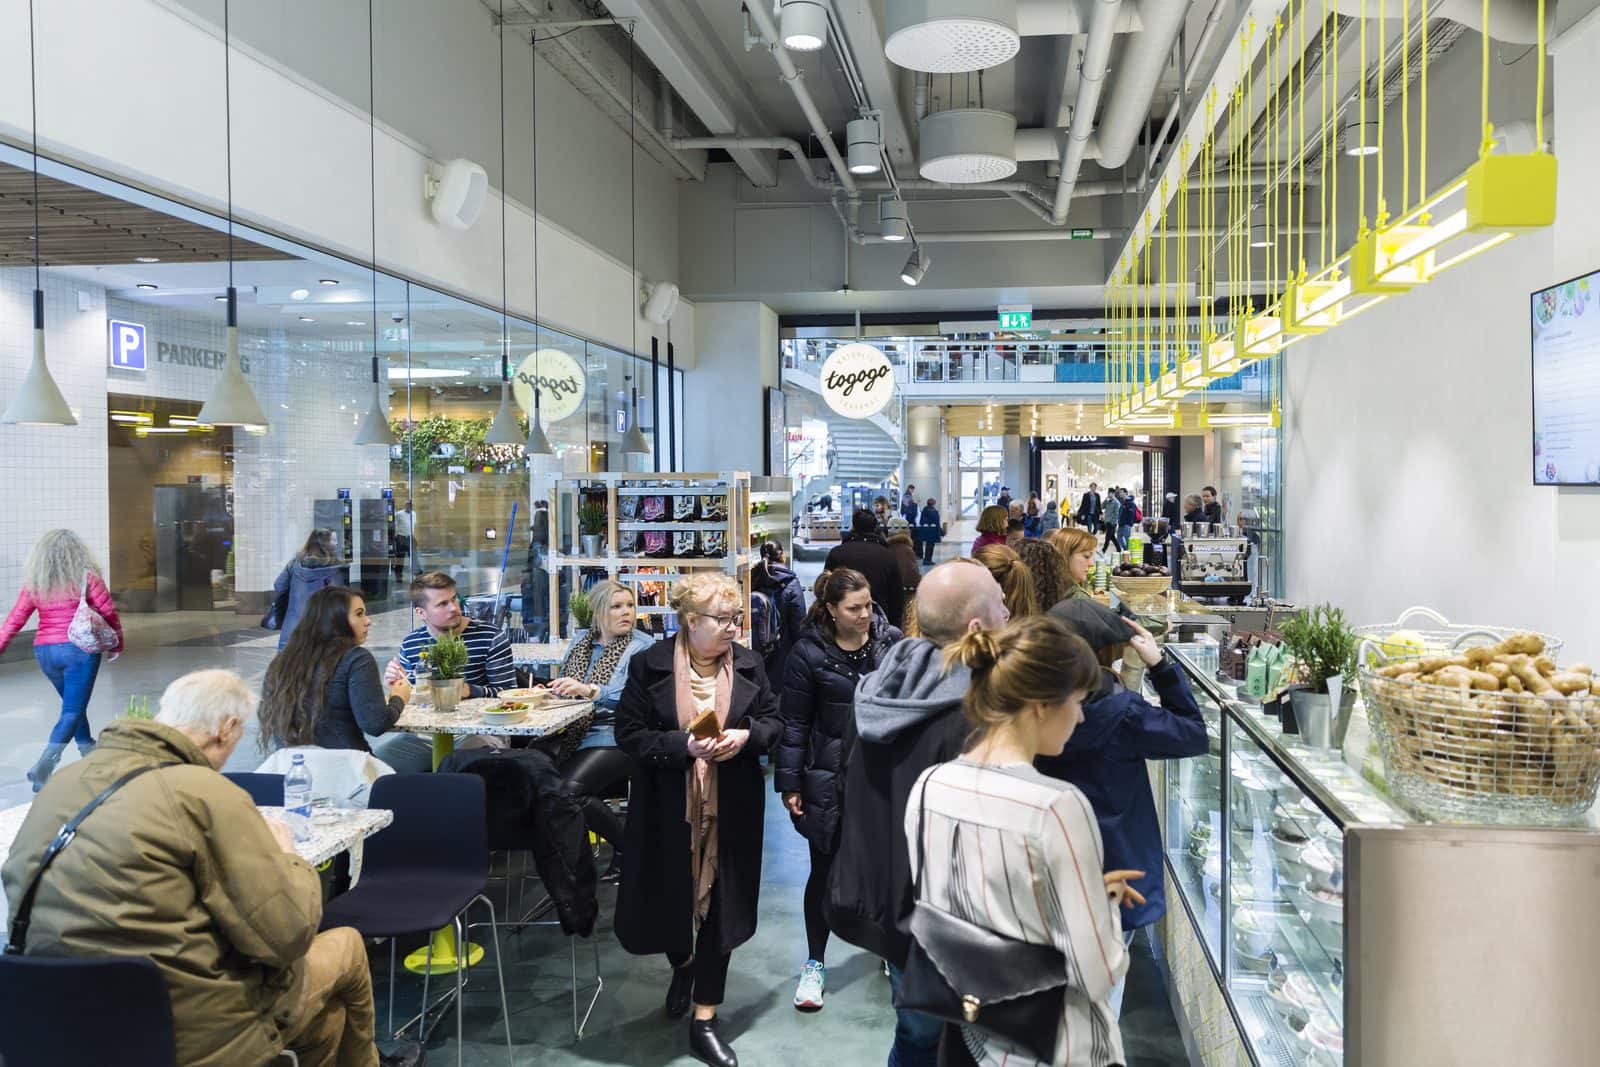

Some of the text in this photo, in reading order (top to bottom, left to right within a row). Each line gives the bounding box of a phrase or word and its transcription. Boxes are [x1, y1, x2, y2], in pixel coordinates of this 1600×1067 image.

[119, 326, 140, 364] P
[157, 342, 250, 374] PARKERG
[824, 364, 891, 397] togogo
